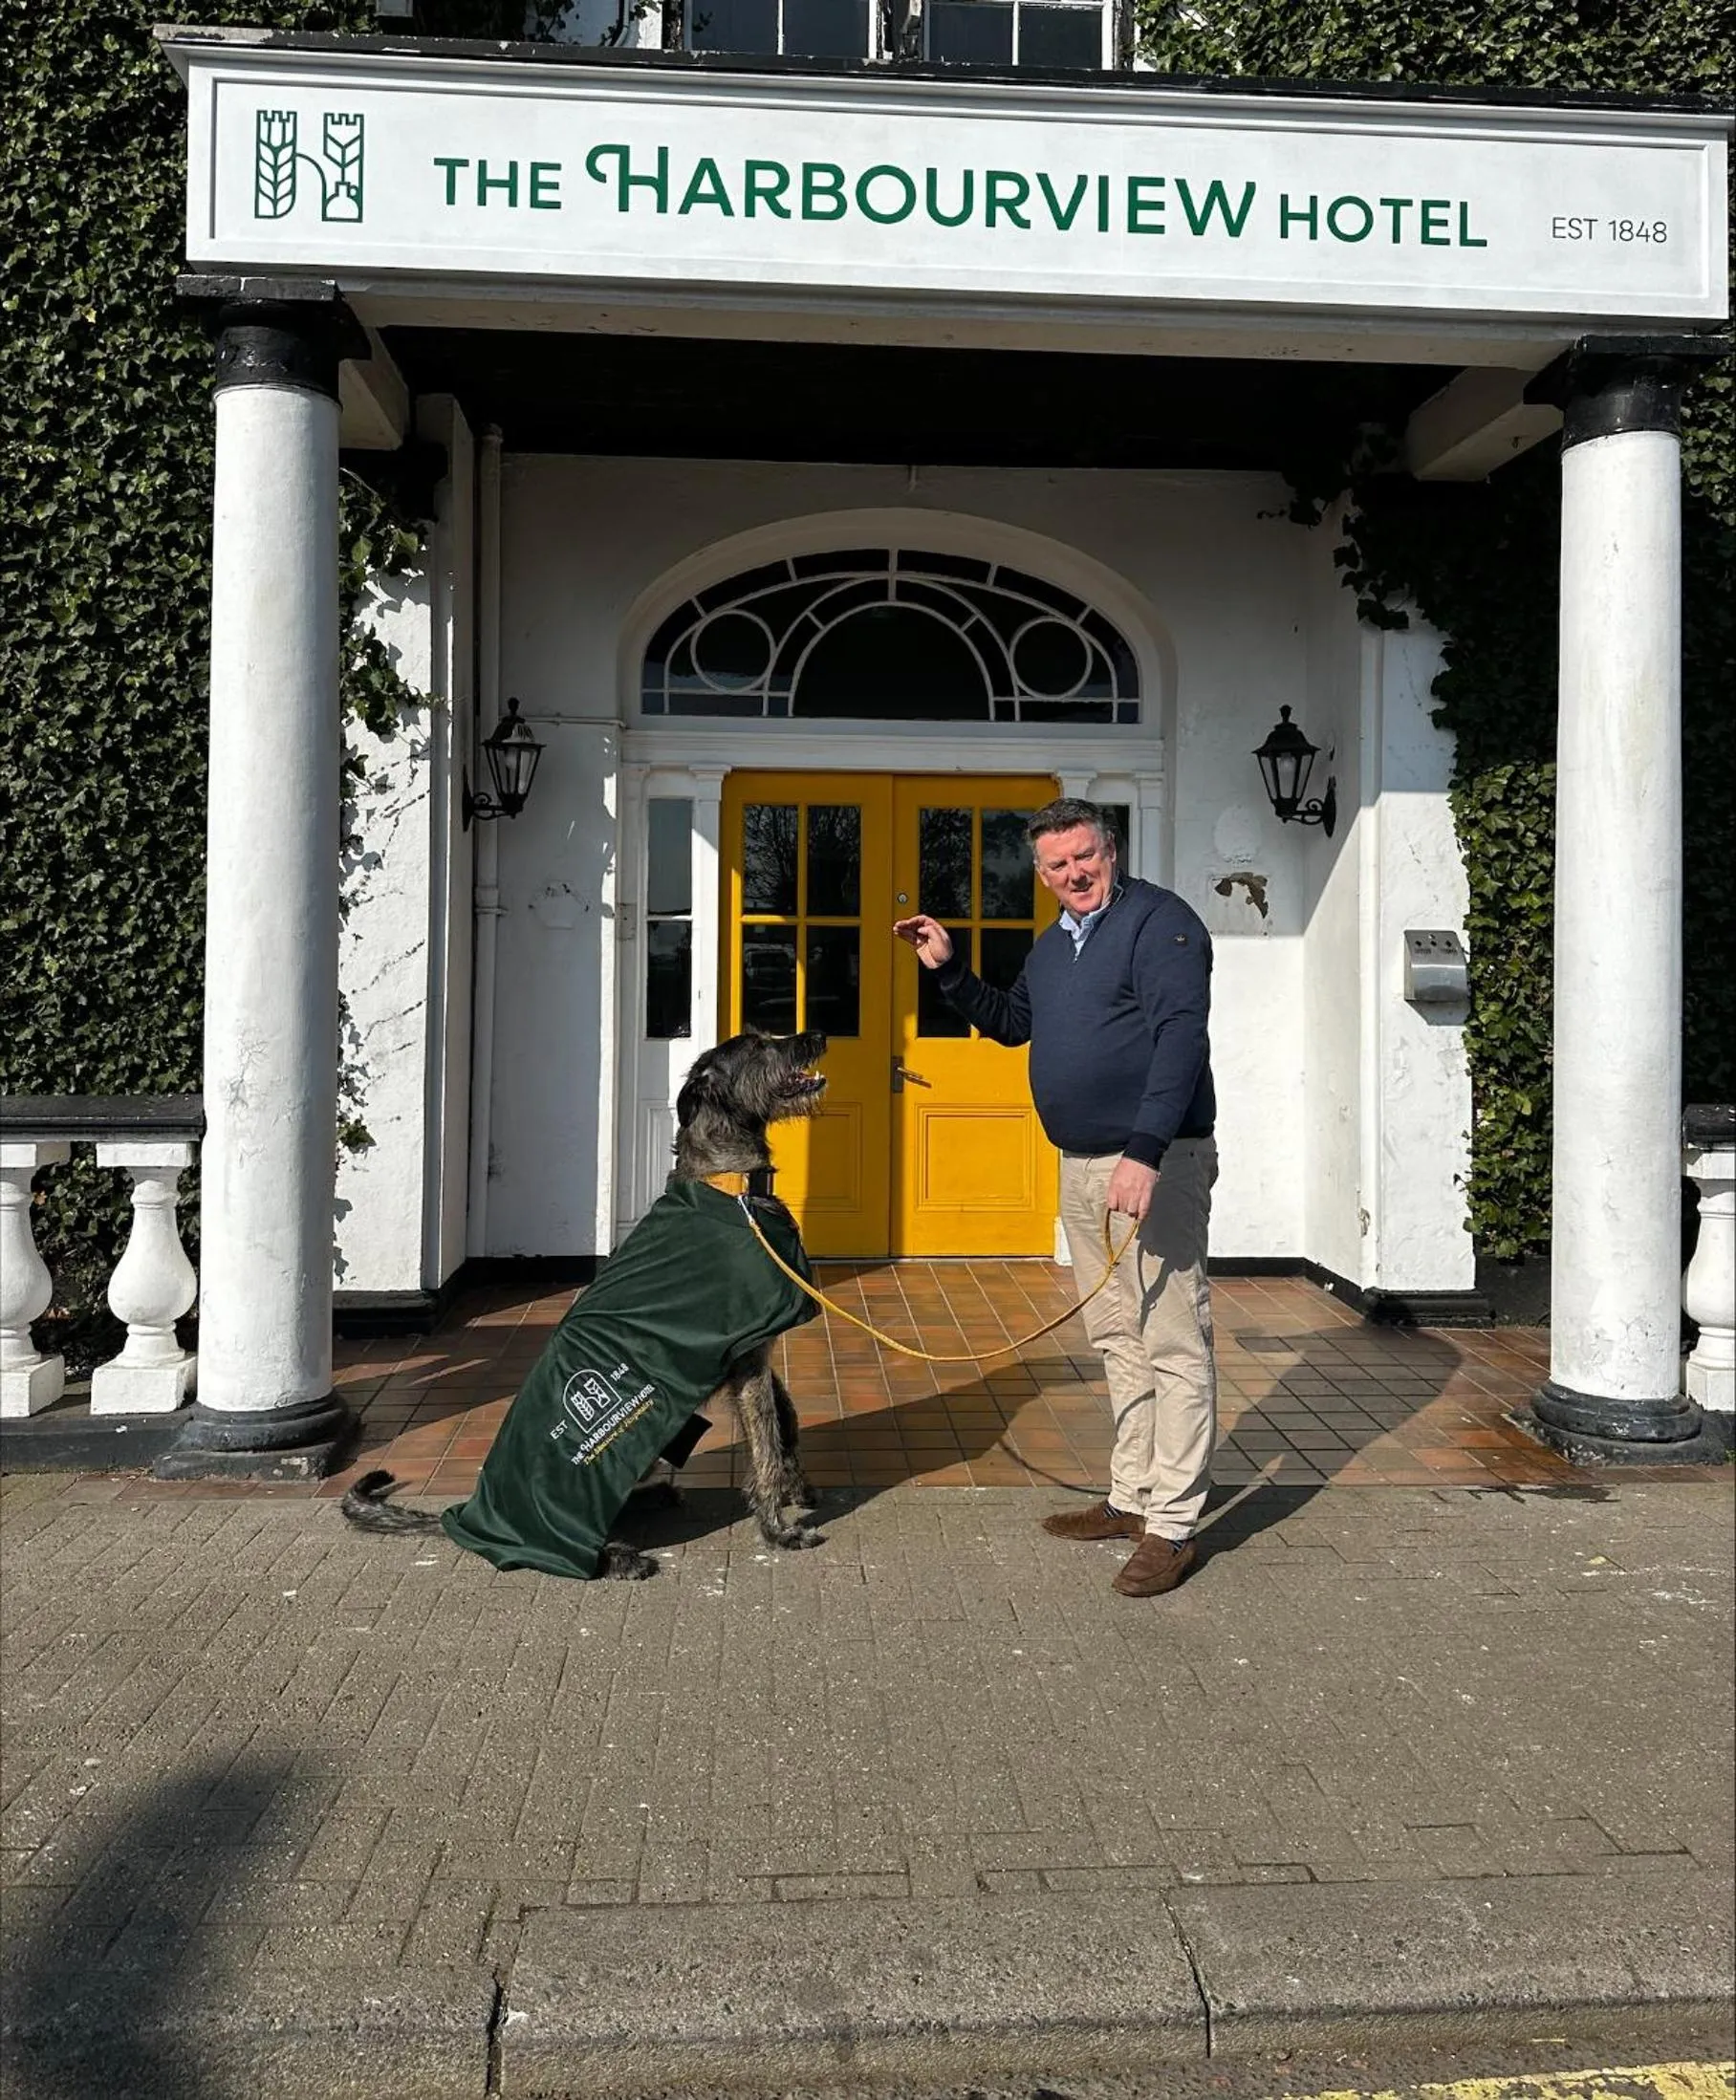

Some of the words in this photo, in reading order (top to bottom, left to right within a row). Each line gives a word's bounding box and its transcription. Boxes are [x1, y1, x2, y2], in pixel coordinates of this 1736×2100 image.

[433, 157, 562, 210] THE
[585, 143, 1257, 238] HARBOURVIEW
[1280, 193, 1487, 249] HOTEL
[1552, 216, 1599, 241] EST
[1608, 219, 1667, 244] 1848
[550, 1419, 568, 1440] EST
[571, 1451, 584, 1465] THE
[580, 1396, 640, 1452] HARBOURVIEW
